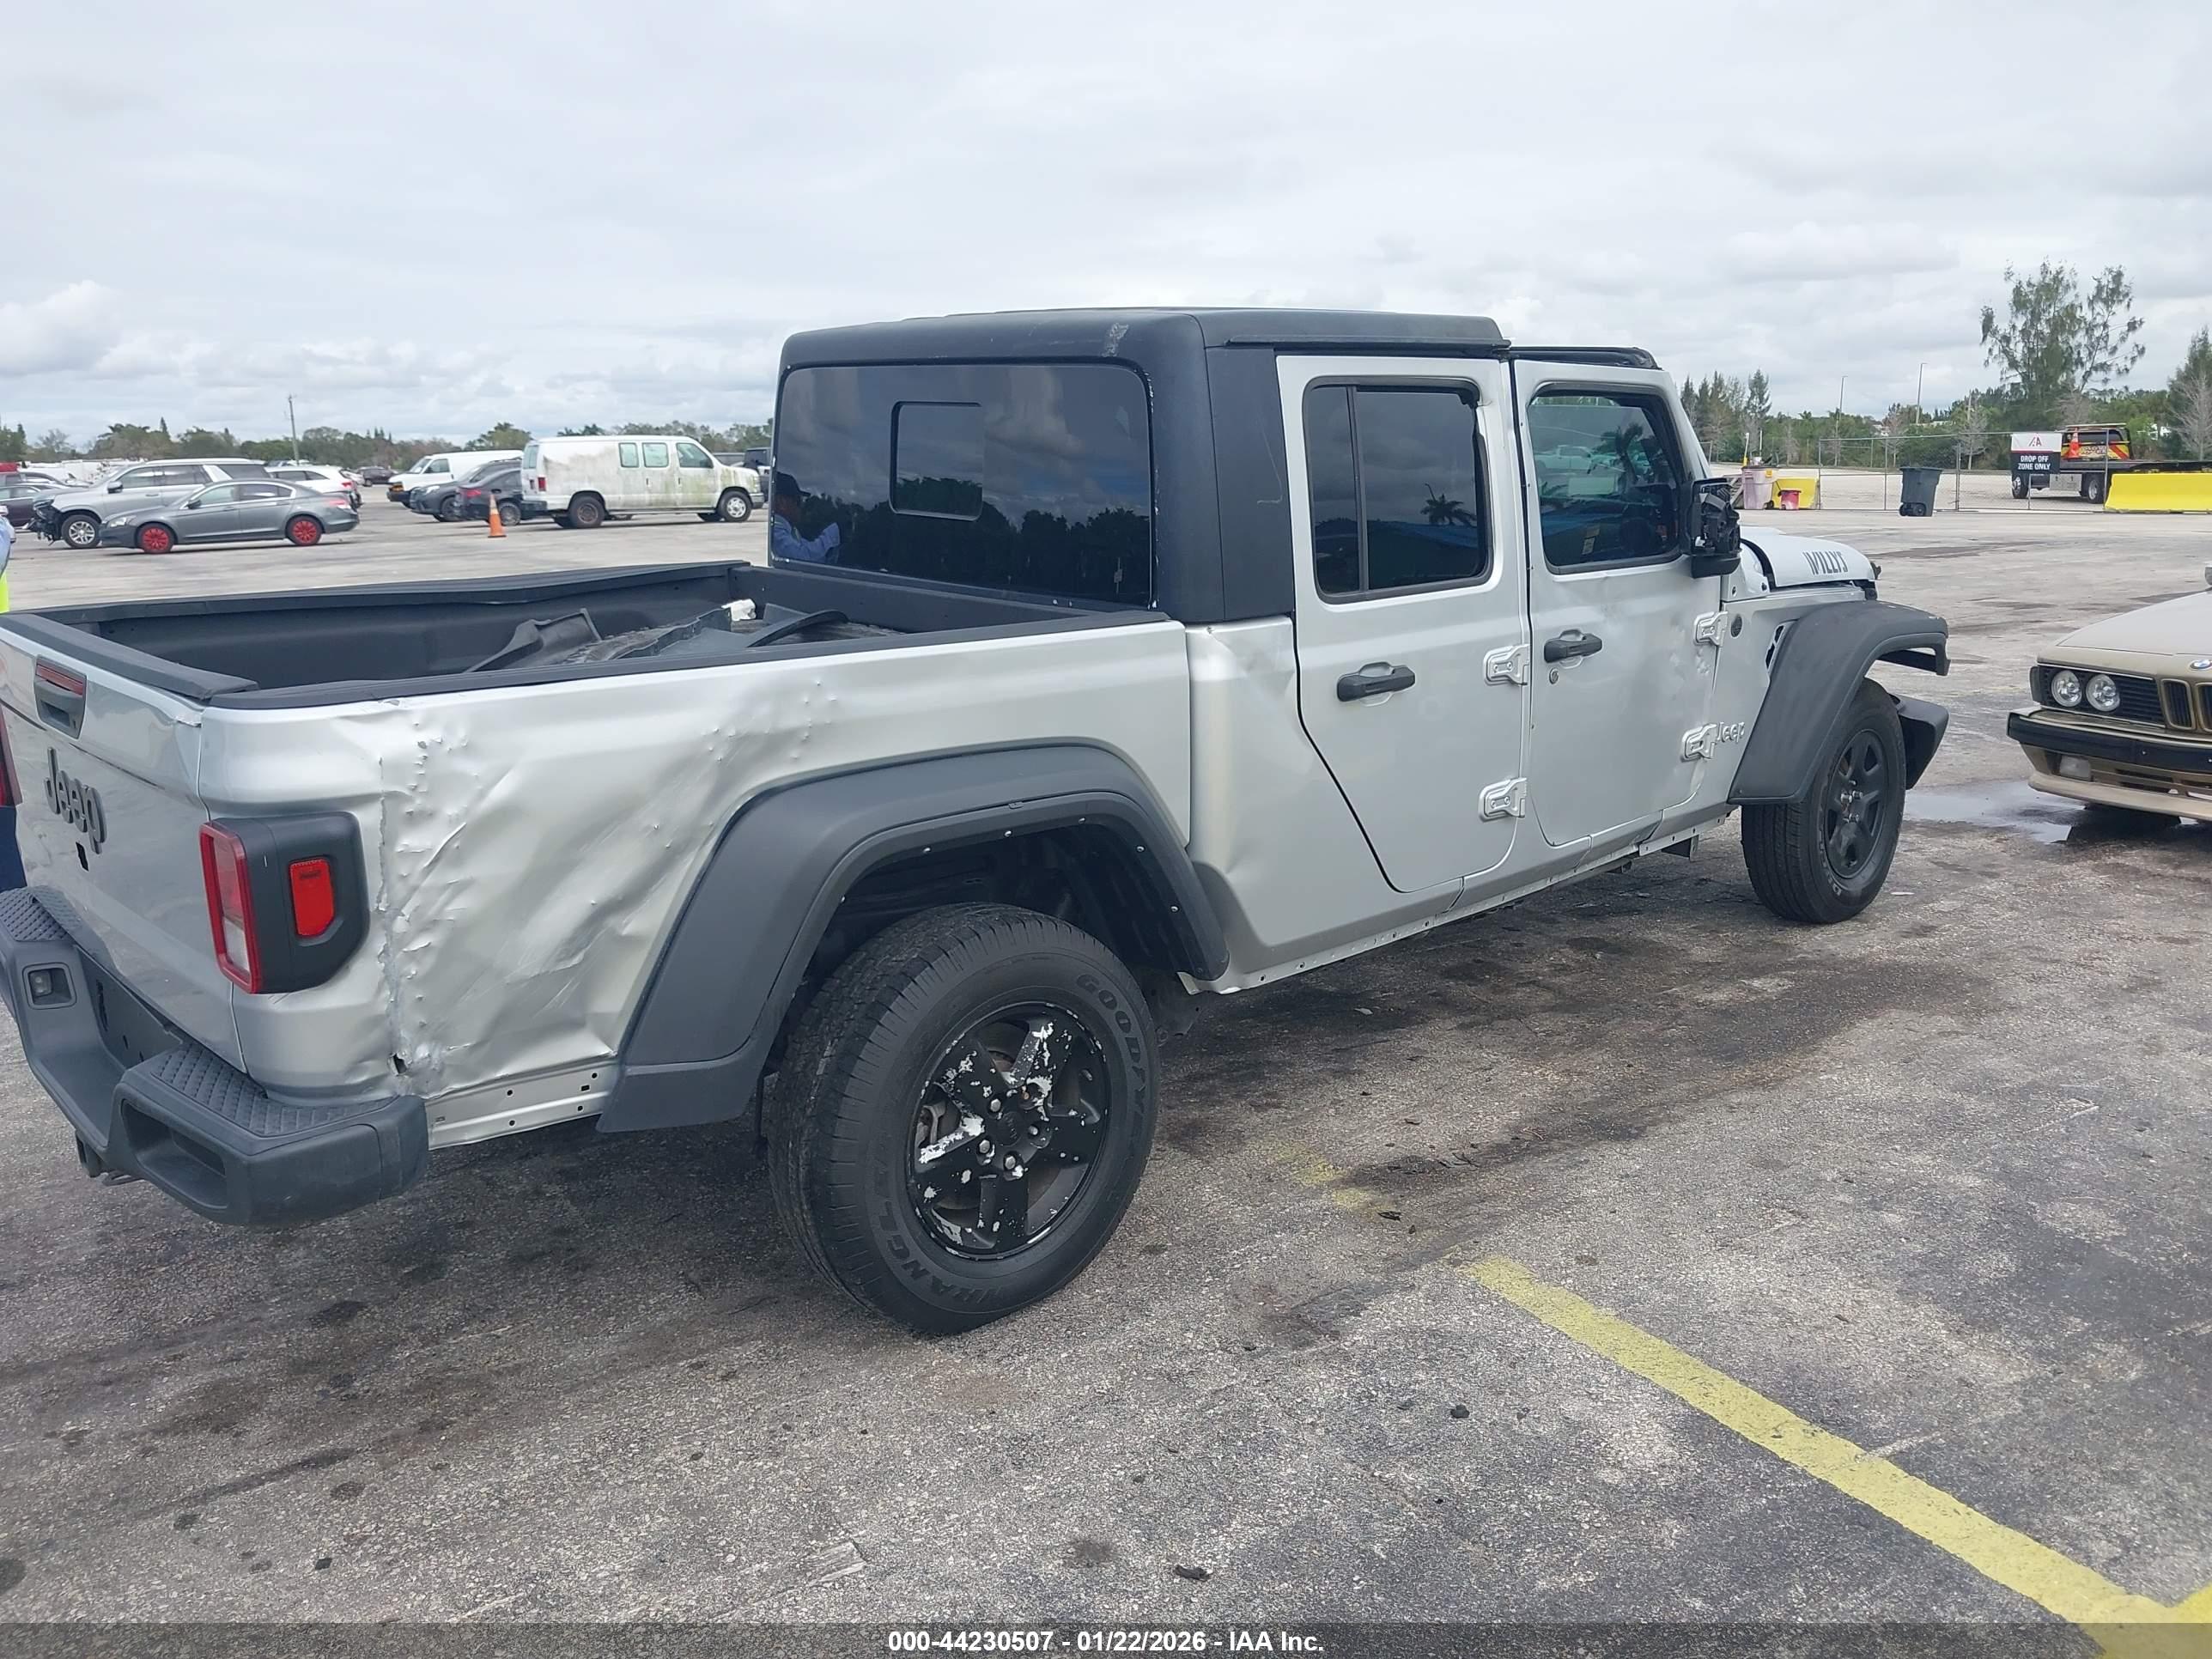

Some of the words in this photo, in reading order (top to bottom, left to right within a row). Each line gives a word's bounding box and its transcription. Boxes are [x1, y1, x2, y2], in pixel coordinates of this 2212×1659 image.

[1802, 551, 1849, 574] WILLYS
[1717, 721, 1745, 743] Jeep
[44, 745, 108, 855] Jeep
